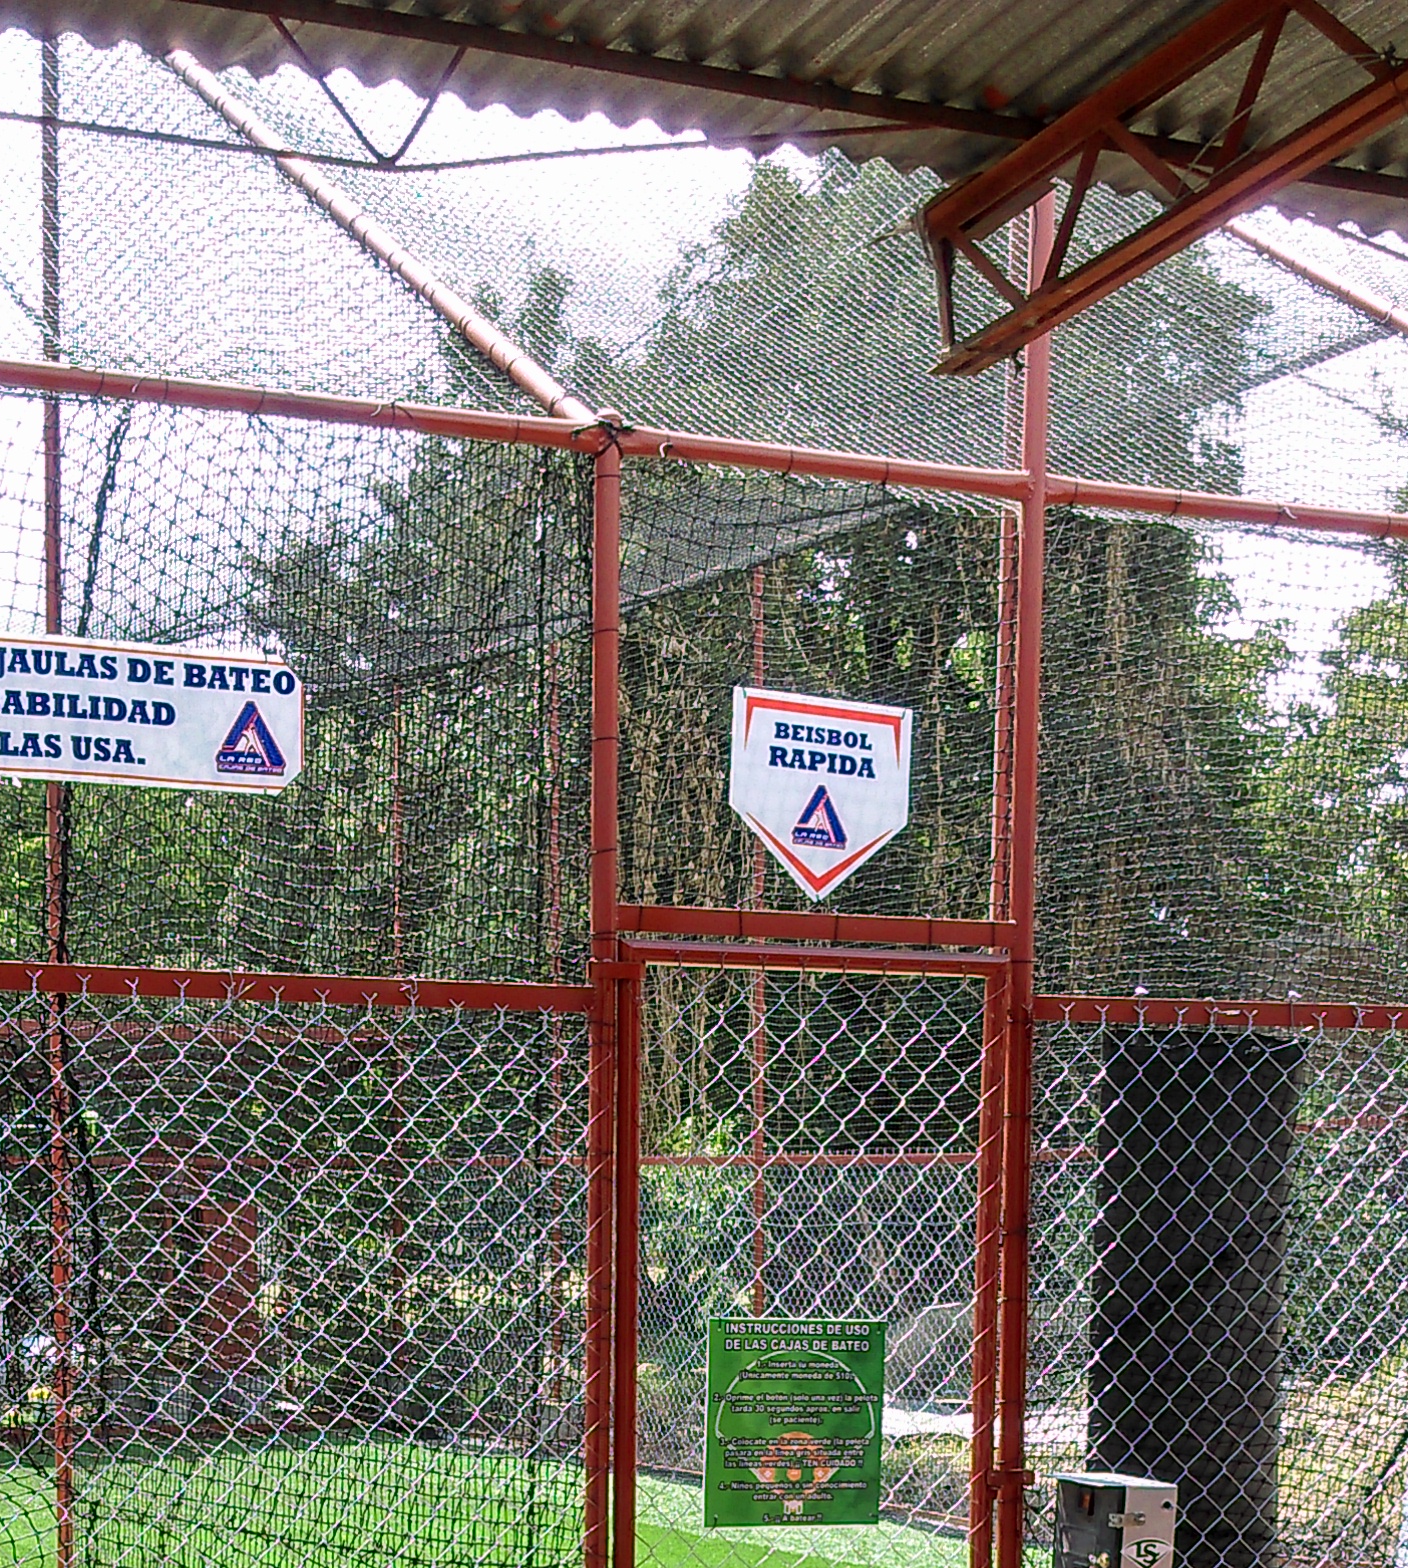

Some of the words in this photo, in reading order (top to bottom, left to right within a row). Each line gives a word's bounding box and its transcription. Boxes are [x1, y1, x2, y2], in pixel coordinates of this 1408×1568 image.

[127, 657, 175, 686] DE
[183, 662, 296, 696] BATEO
[70, 735, 146, 765] USA.
[774, 722, 873, 751] BEISBOL
[768, 745, 876, 779] RAPIDA
[726, 1323, 823, 1334] INSTRUCCIONES
[827, 1325, 842, 1334] DE
[845, 1325, 870, 1335] USO
[725, 1340, 741, 1350] DE
[745, 1340, 767, 1350] LAS
[771, 1340, 809, 1350] CAJAS
[813, 1340, 828, 1350] DE
[832, 1341, 869, 1351] BATEO
[1135, 1542, 1160, 1564] LS
